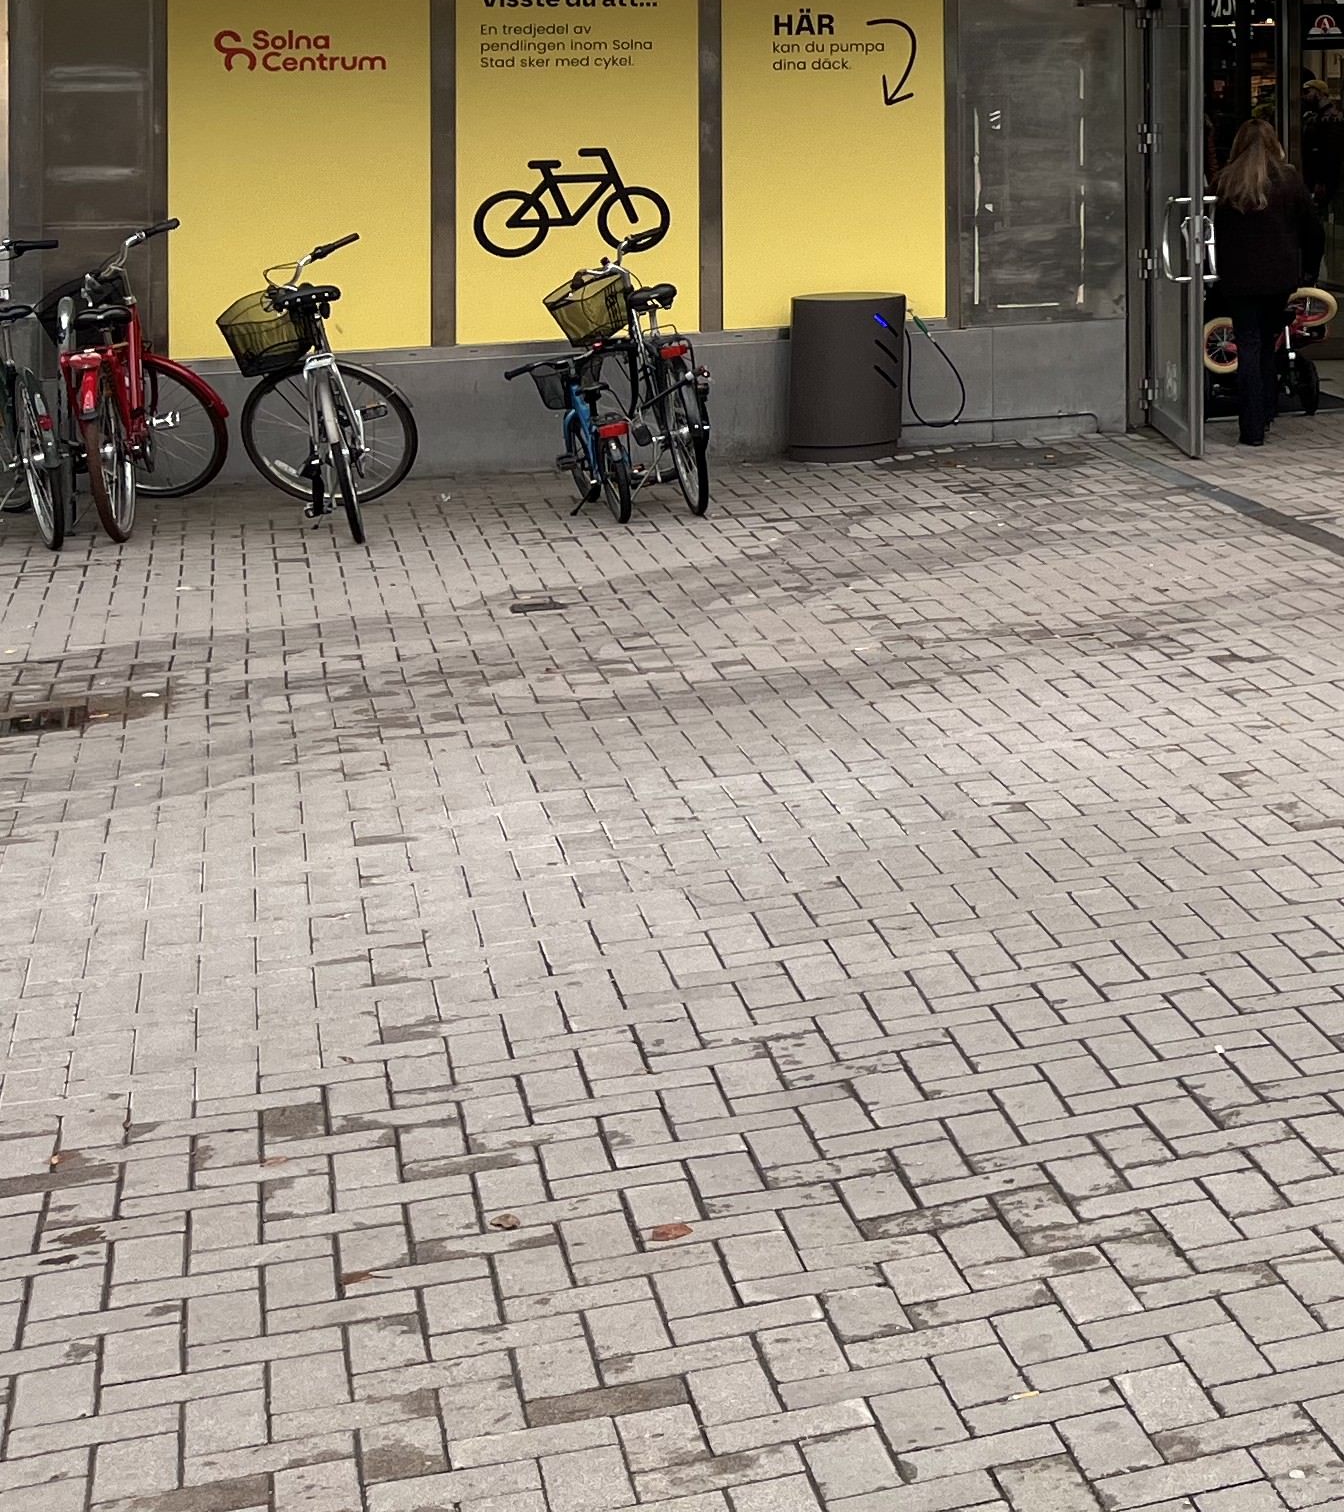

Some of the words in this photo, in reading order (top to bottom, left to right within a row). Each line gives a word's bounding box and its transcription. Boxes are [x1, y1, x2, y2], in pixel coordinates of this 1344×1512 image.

[773, 8, 835, 36] HÄR
[480, 24, 498, 36] En
[502, 23, 570, 38] tredjedel
[573, 25, 592, 36] av
[252, 29, 331, 50] Solna
[480, 39, 566, 55] pendlingen
[570, 39, 608, 51] inom
[612, 39, 653, 50] Solna
[772, 41, 801, 54] kan
[805, 41, 825, 54] du
[829, 42, 885, 55] pumpa
[262, 52, 387, 72] Centrum
[480, 56, 515, 68] Stad
[520, 56, 550, 68] sker
[555, 55, 590, 67] med
[594, 55, 635, 69] cykel.
[772, 59, 807, 71] dina
[811, 58, 852, 71] däck.
